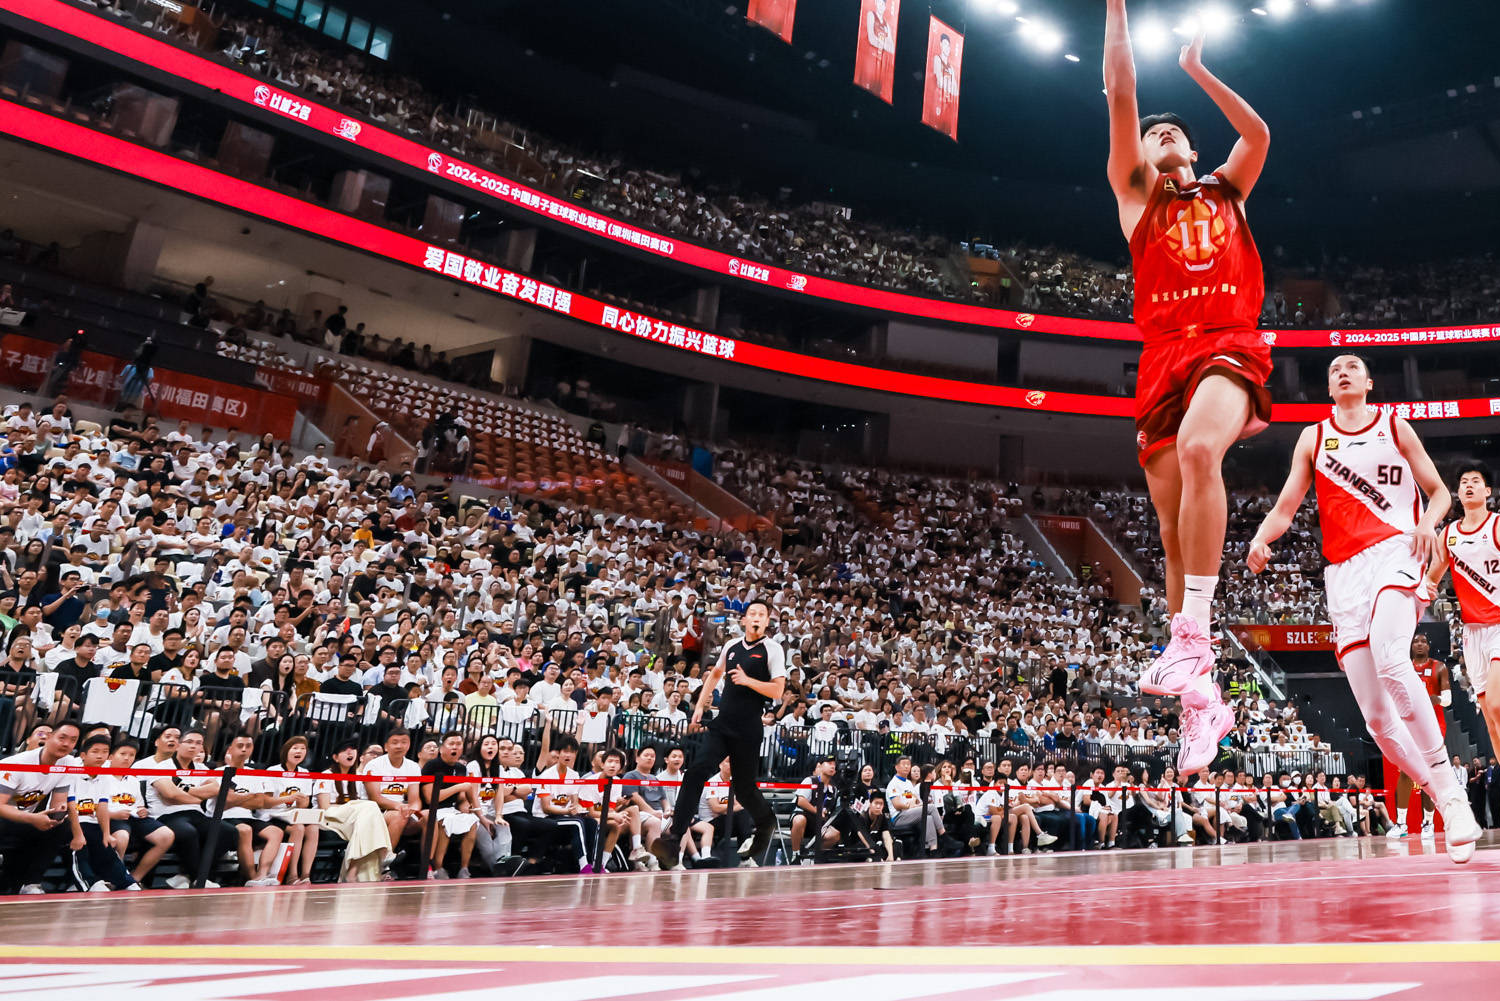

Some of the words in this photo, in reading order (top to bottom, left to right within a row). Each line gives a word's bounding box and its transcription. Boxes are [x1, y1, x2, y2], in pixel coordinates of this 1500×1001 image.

[423, 245, 573, 314] 爱国敬业奋发图强
[602, 305, 736, 360] 同心协力振兴篮球
[1325, 454, 1392, 513] JIANGSU
[1377, 464, 1403, 486] 50
[1450, 551, 1497, 595] JIANGSU
[1483, 559, 1500, 575] 12
